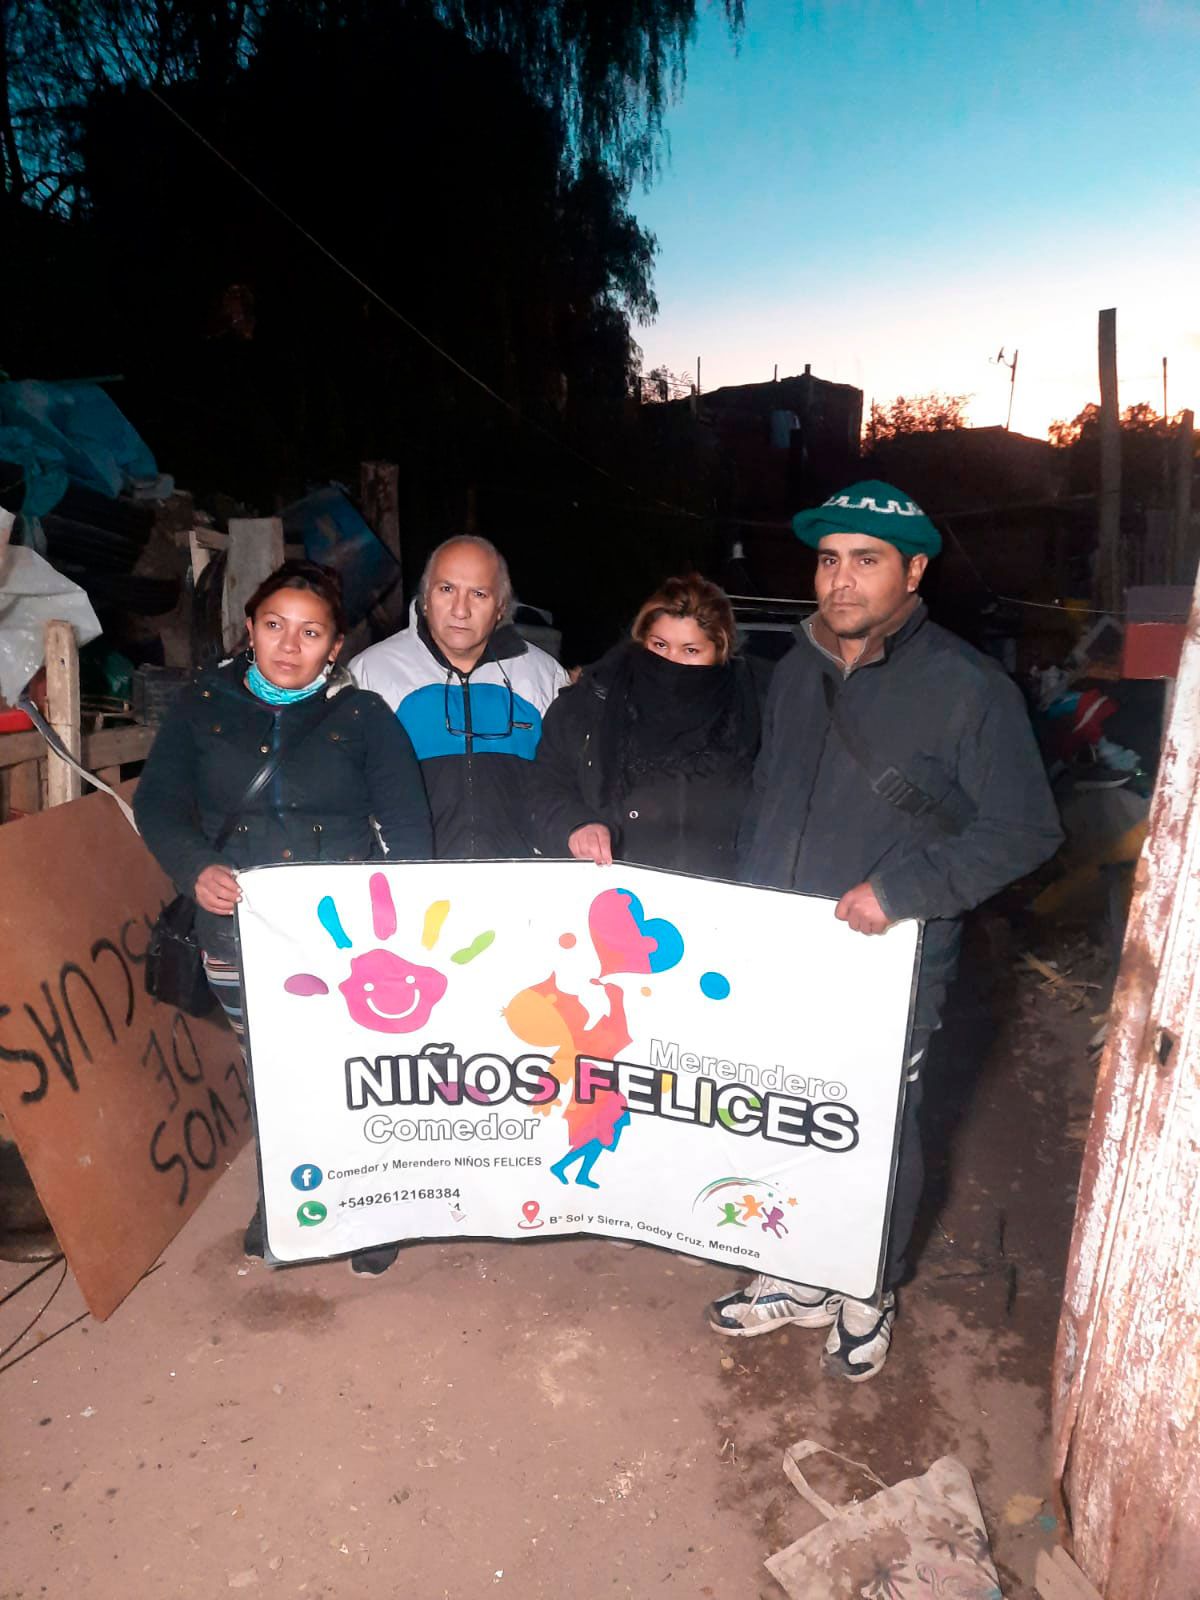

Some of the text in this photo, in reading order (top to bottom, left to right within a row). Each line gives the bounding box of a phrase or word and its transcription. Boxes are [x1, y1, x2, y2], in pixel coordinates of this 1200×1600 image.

[0, 898, 166, 1104] SCUAS
[141, 1011, 204, 1112] DE
[650, 1038, 848, 1101] Merendero
[345, 1042, 859, 1153] NIÑOS FELICES
[363, 1114, 541, 1144] Comedor
[150, 1062, 250, 1207] EVOS
[327, 1155, 542, 1180] Comedor y Merendero NIÑOS FELICES
[338, 1187, 461, 1209] +5492612168384
[566, 1214, 584, 1223] Sol
[587, 1216, 594, 1224] y
[597, 1215, 634, 1230] Sierra,
[637, 1221, 673, 1240] Godoy
[676, 1232, 705, 1248] Cruz,
[708, 1240, 761, 1259] Mendoza
